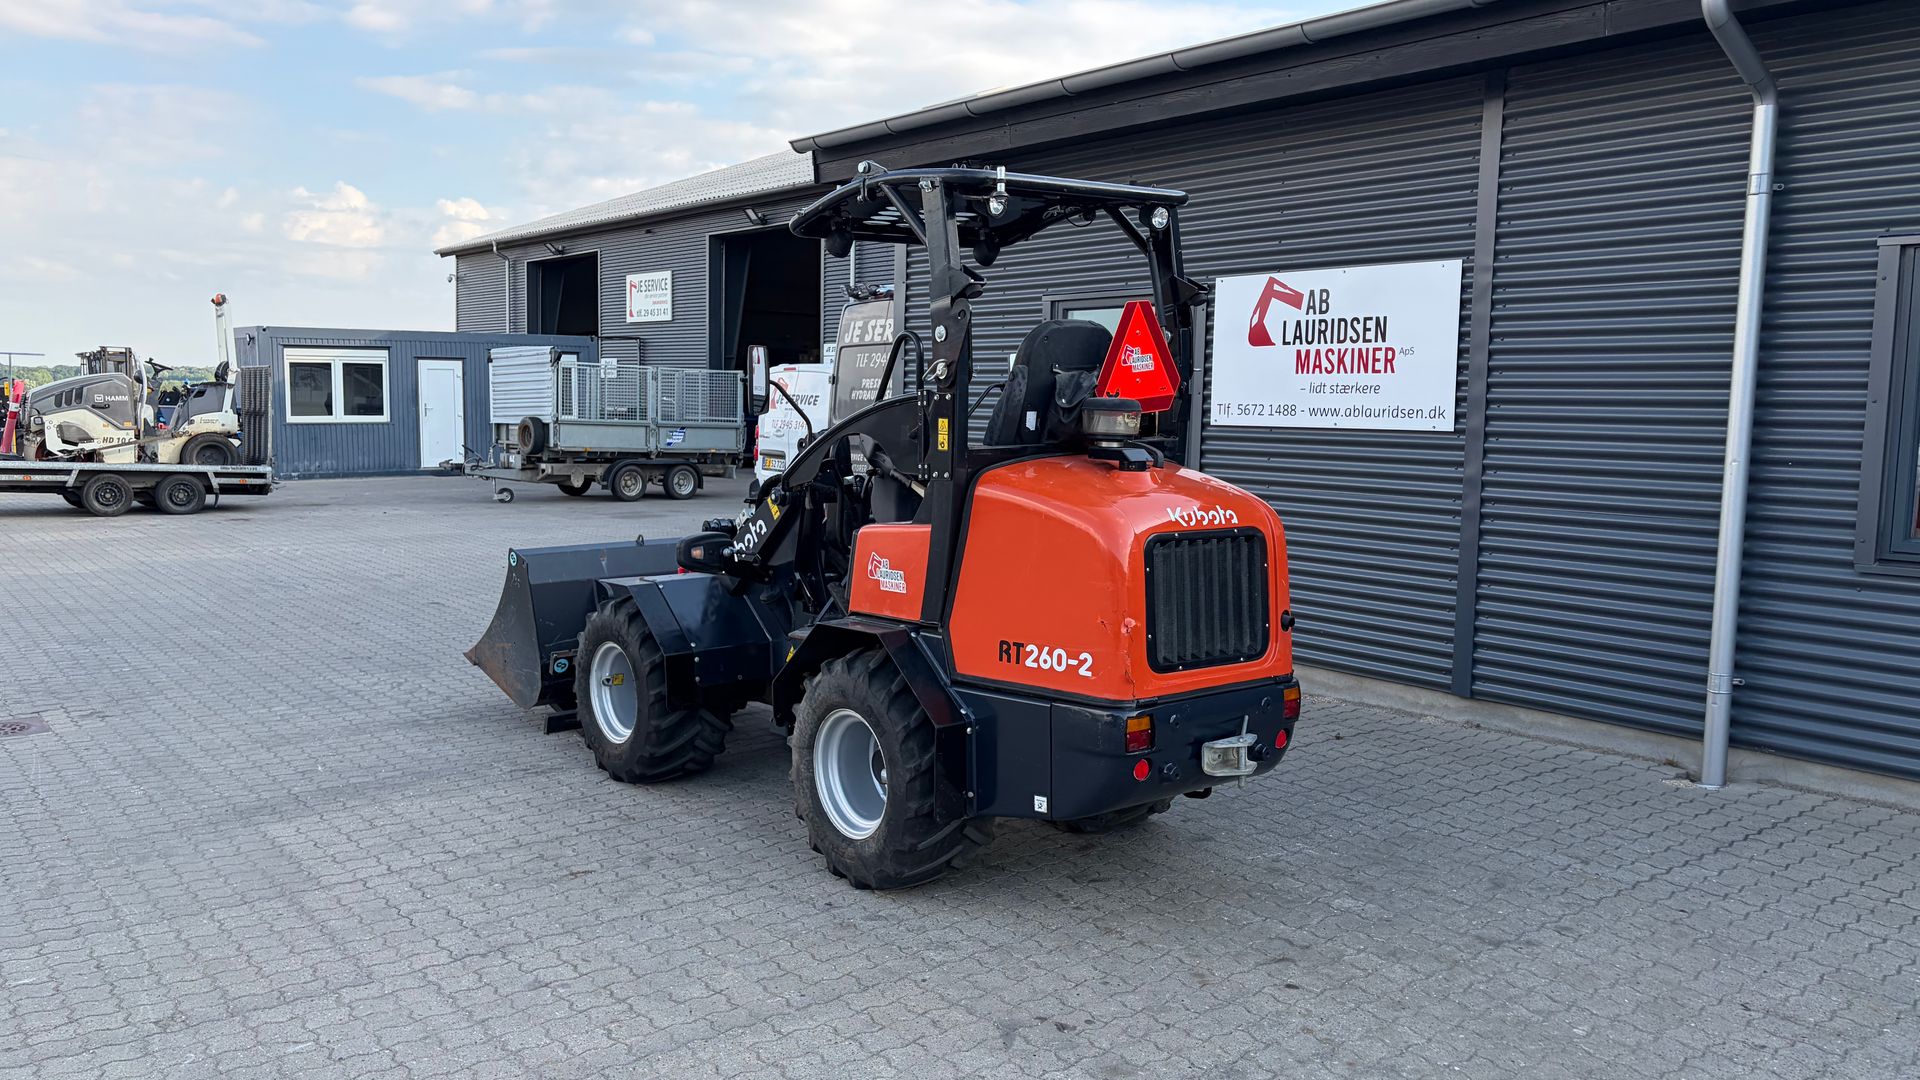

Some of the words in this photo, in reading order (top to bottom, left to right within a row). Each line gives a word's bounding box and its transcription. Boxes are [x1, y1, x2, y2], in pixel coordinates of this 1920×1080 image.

[636, 280, 643, 293] JE
[644, 278, 668, 292] SERVICE
[1305, 288, 1330, 316] AB
[844, 320, 863, 344] JE
[1282, 315, 1388, 346] LAURIDSEN
[856, 353, 869, 368] TLF
[1295, 346, 1396, 375] MASKINER
[1398, 346, 1415, 356] ApS
[1308, 381, 1327, 394] lidt
[1329, 382, 1381, 395] stærkere
[1217, 402, 1234, 418] Tlf.
[1237, 403, 1265, 417] 5672
[1268, 403, 1297, 416] 1488
[1308, 404, 1446, 420] www.ablauridsen.dk
[102, 436, 114, 444] HD
[117, 436, 126, 444] 10
[1166, 504, 1239, 527] Kubota
[877, 570, 905, 582] LAURIDSEN
[880, 580, 906, 593] MASKINER
[998, 639, 1093, 677] RT260-2
